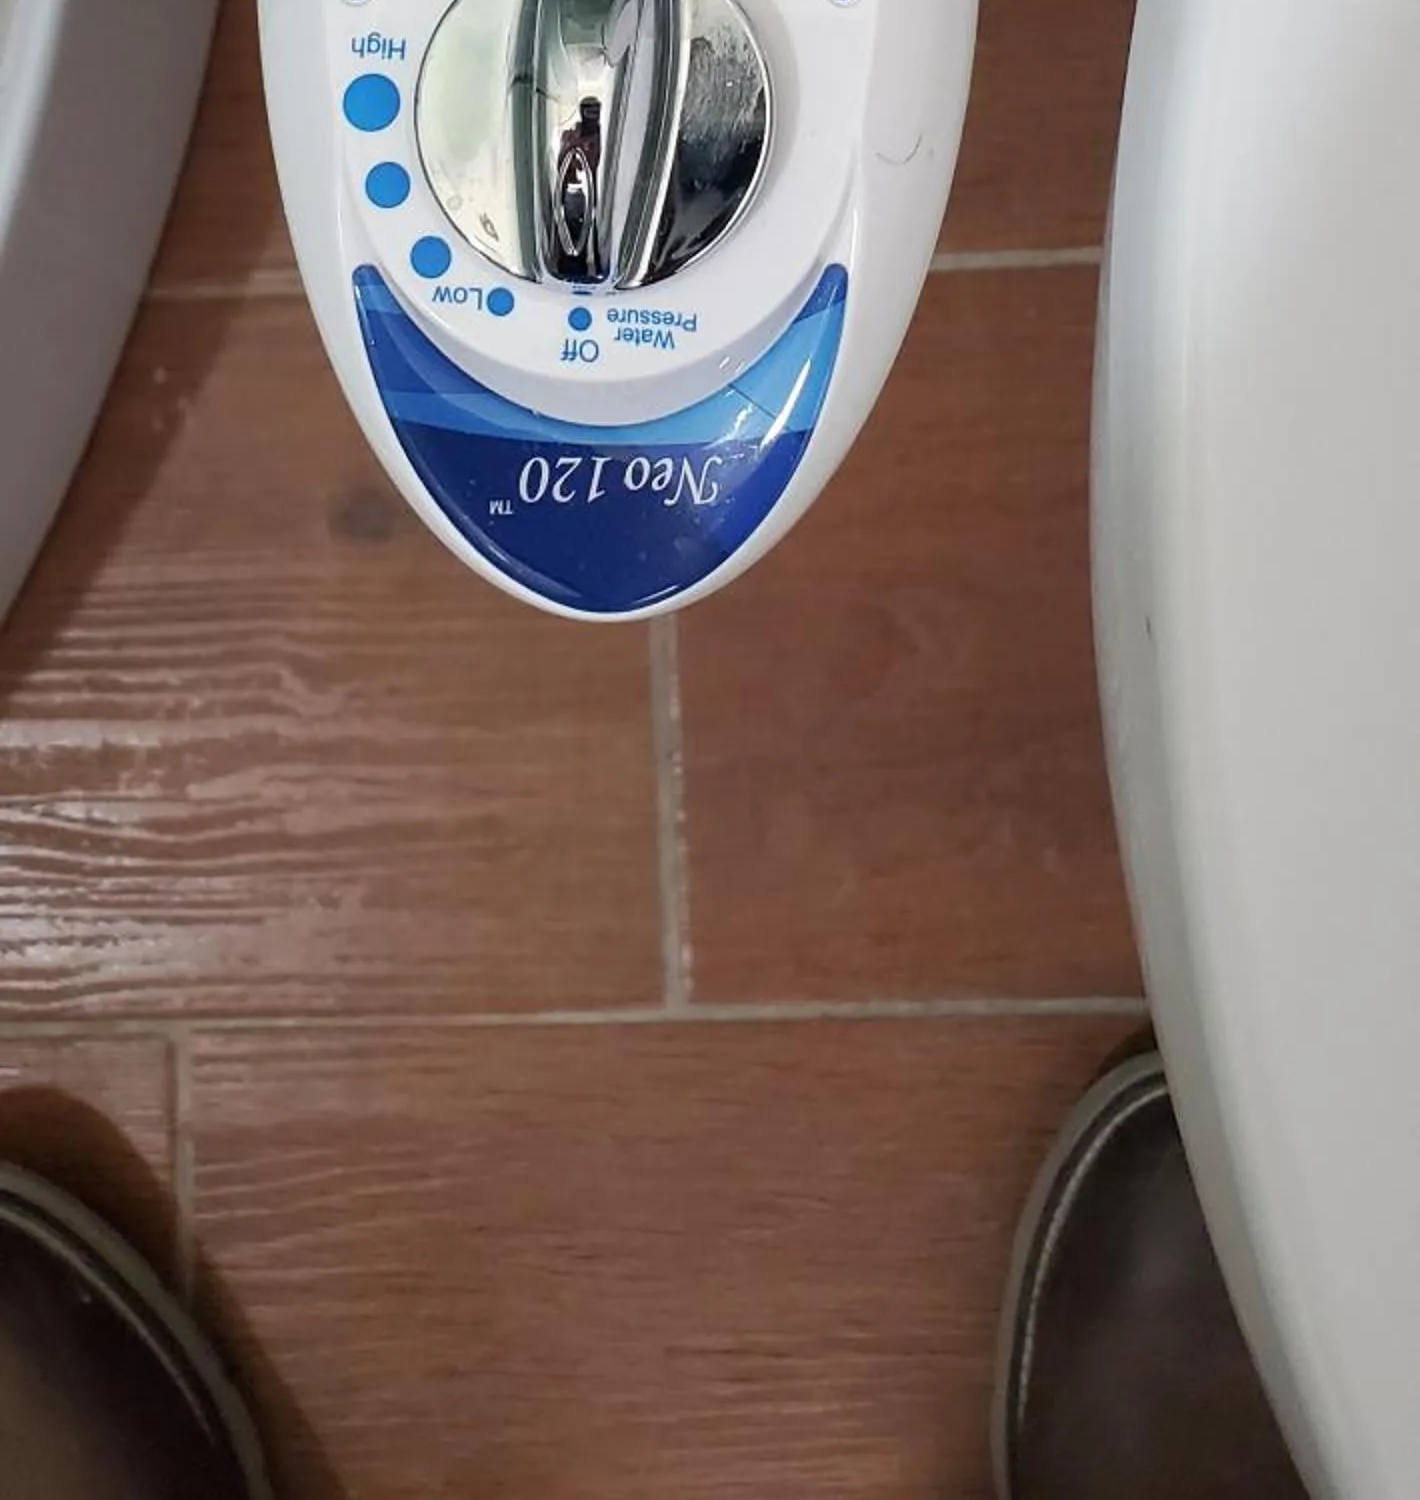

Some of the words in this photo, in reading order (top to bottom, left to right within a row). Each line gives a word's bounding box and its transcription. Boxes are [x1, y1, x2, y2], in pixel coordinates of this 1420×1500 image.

[351, 36, 407, 60] High
[432, 286, 483, 309] Low
[607, 307, 697, 330] Pressure
[560, 338, 599, 362] Off
[614, 329, 676, 349] Water
[623, 455, 723, 505] Neo
